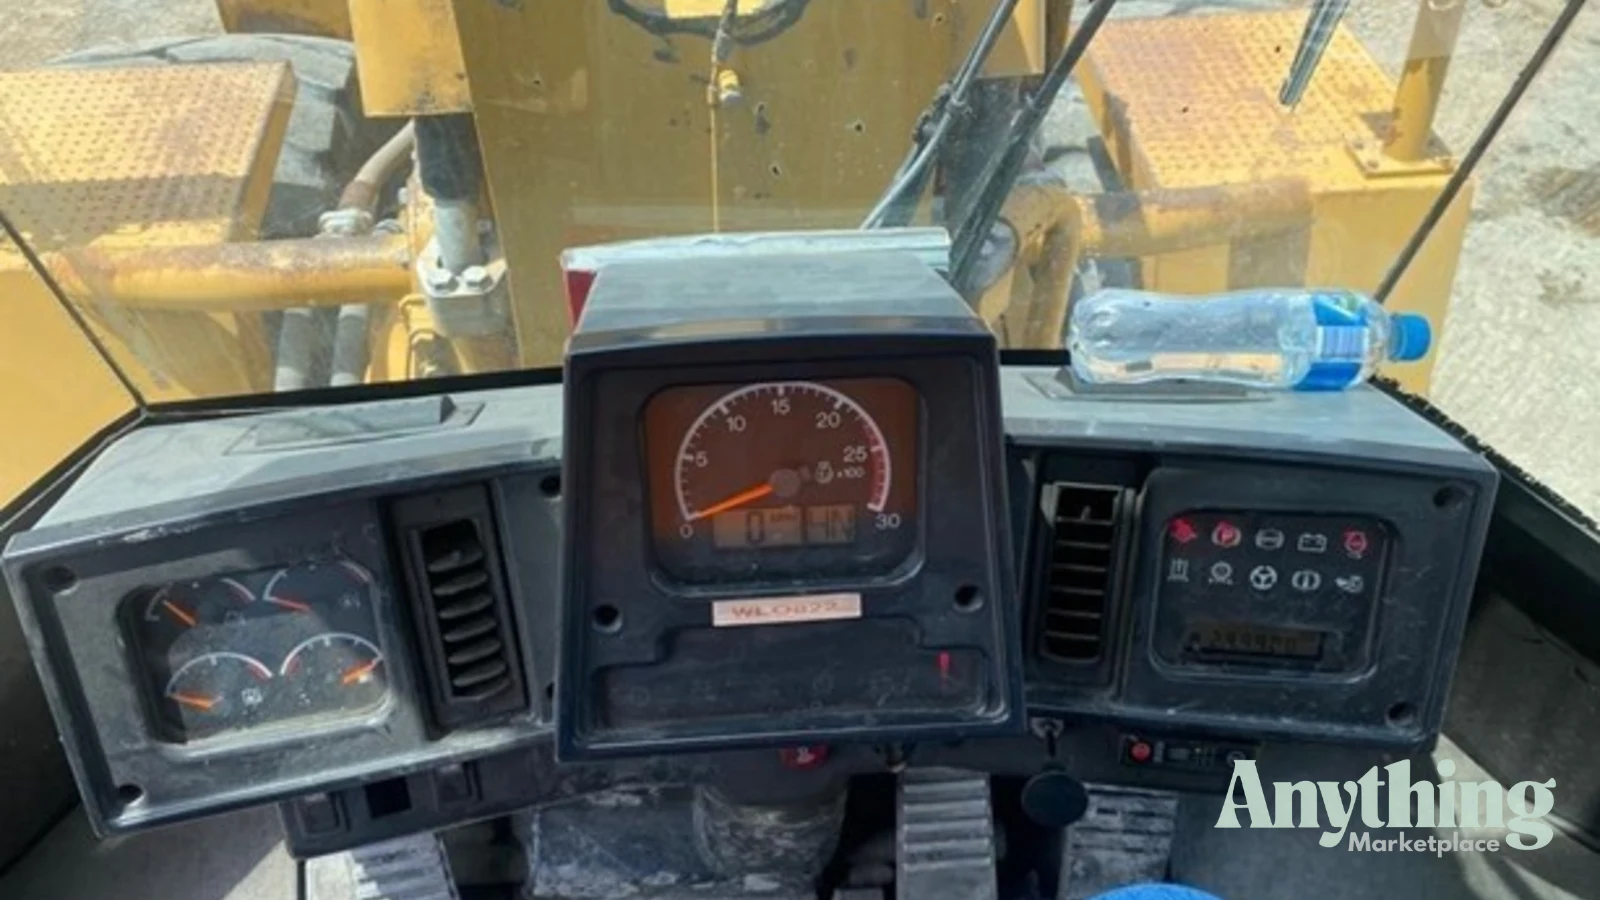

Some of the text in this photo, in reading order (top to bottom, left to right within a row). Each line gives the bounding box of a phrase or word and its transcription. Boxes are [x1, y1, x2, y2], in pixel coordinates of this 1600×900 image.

[771, 400, 790, 415] 15
[727, 416, 747, 432] 10
[816, 412, 841, 428] 20
[695, 451, 708, 467] 5
[843, 446, 868, 462] 25
[875, 513, 901, 529] 30
[679, 523, 693, 539] 0
